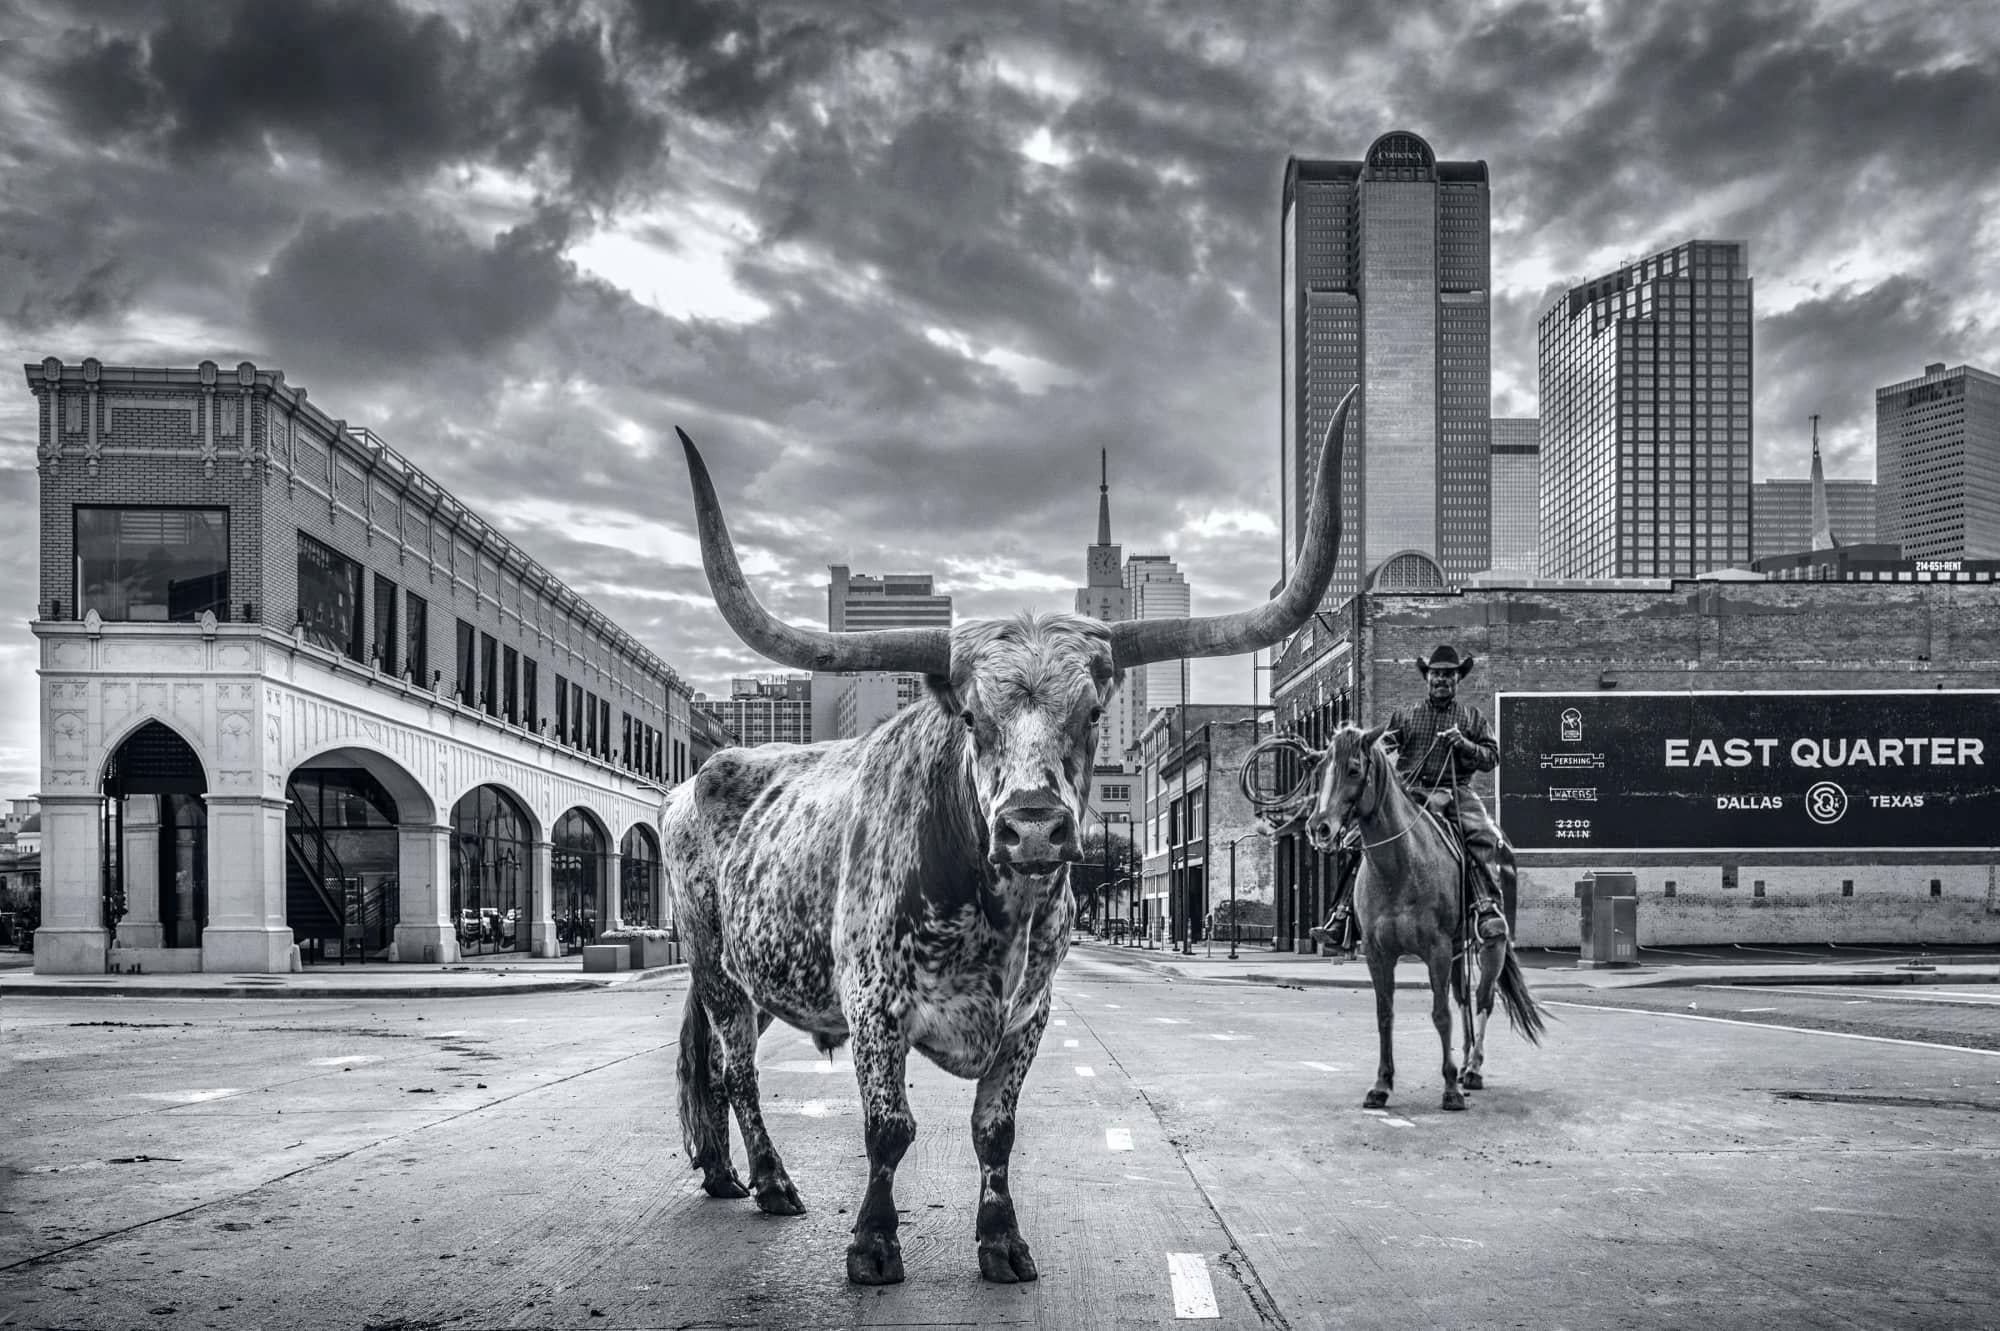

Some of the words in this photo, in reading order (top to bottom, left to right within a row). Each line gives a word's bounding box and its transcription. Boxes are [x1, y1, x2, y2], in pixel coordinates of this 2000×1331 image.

[1665, 738, 1779, 767] EAST
[1790, 737, 1985, 768] QUARTER
[1554, 757, 1591, 765] PERSHING
[1554, 790, 1592, 799] WATERS
[1717, 796, 1783, 809] DALLAS
[1869, 795, 1924, 808] TEXAS
[1557, 819, 1590, 828] 2200
[1557, 830, 1590, 839] MAIN
